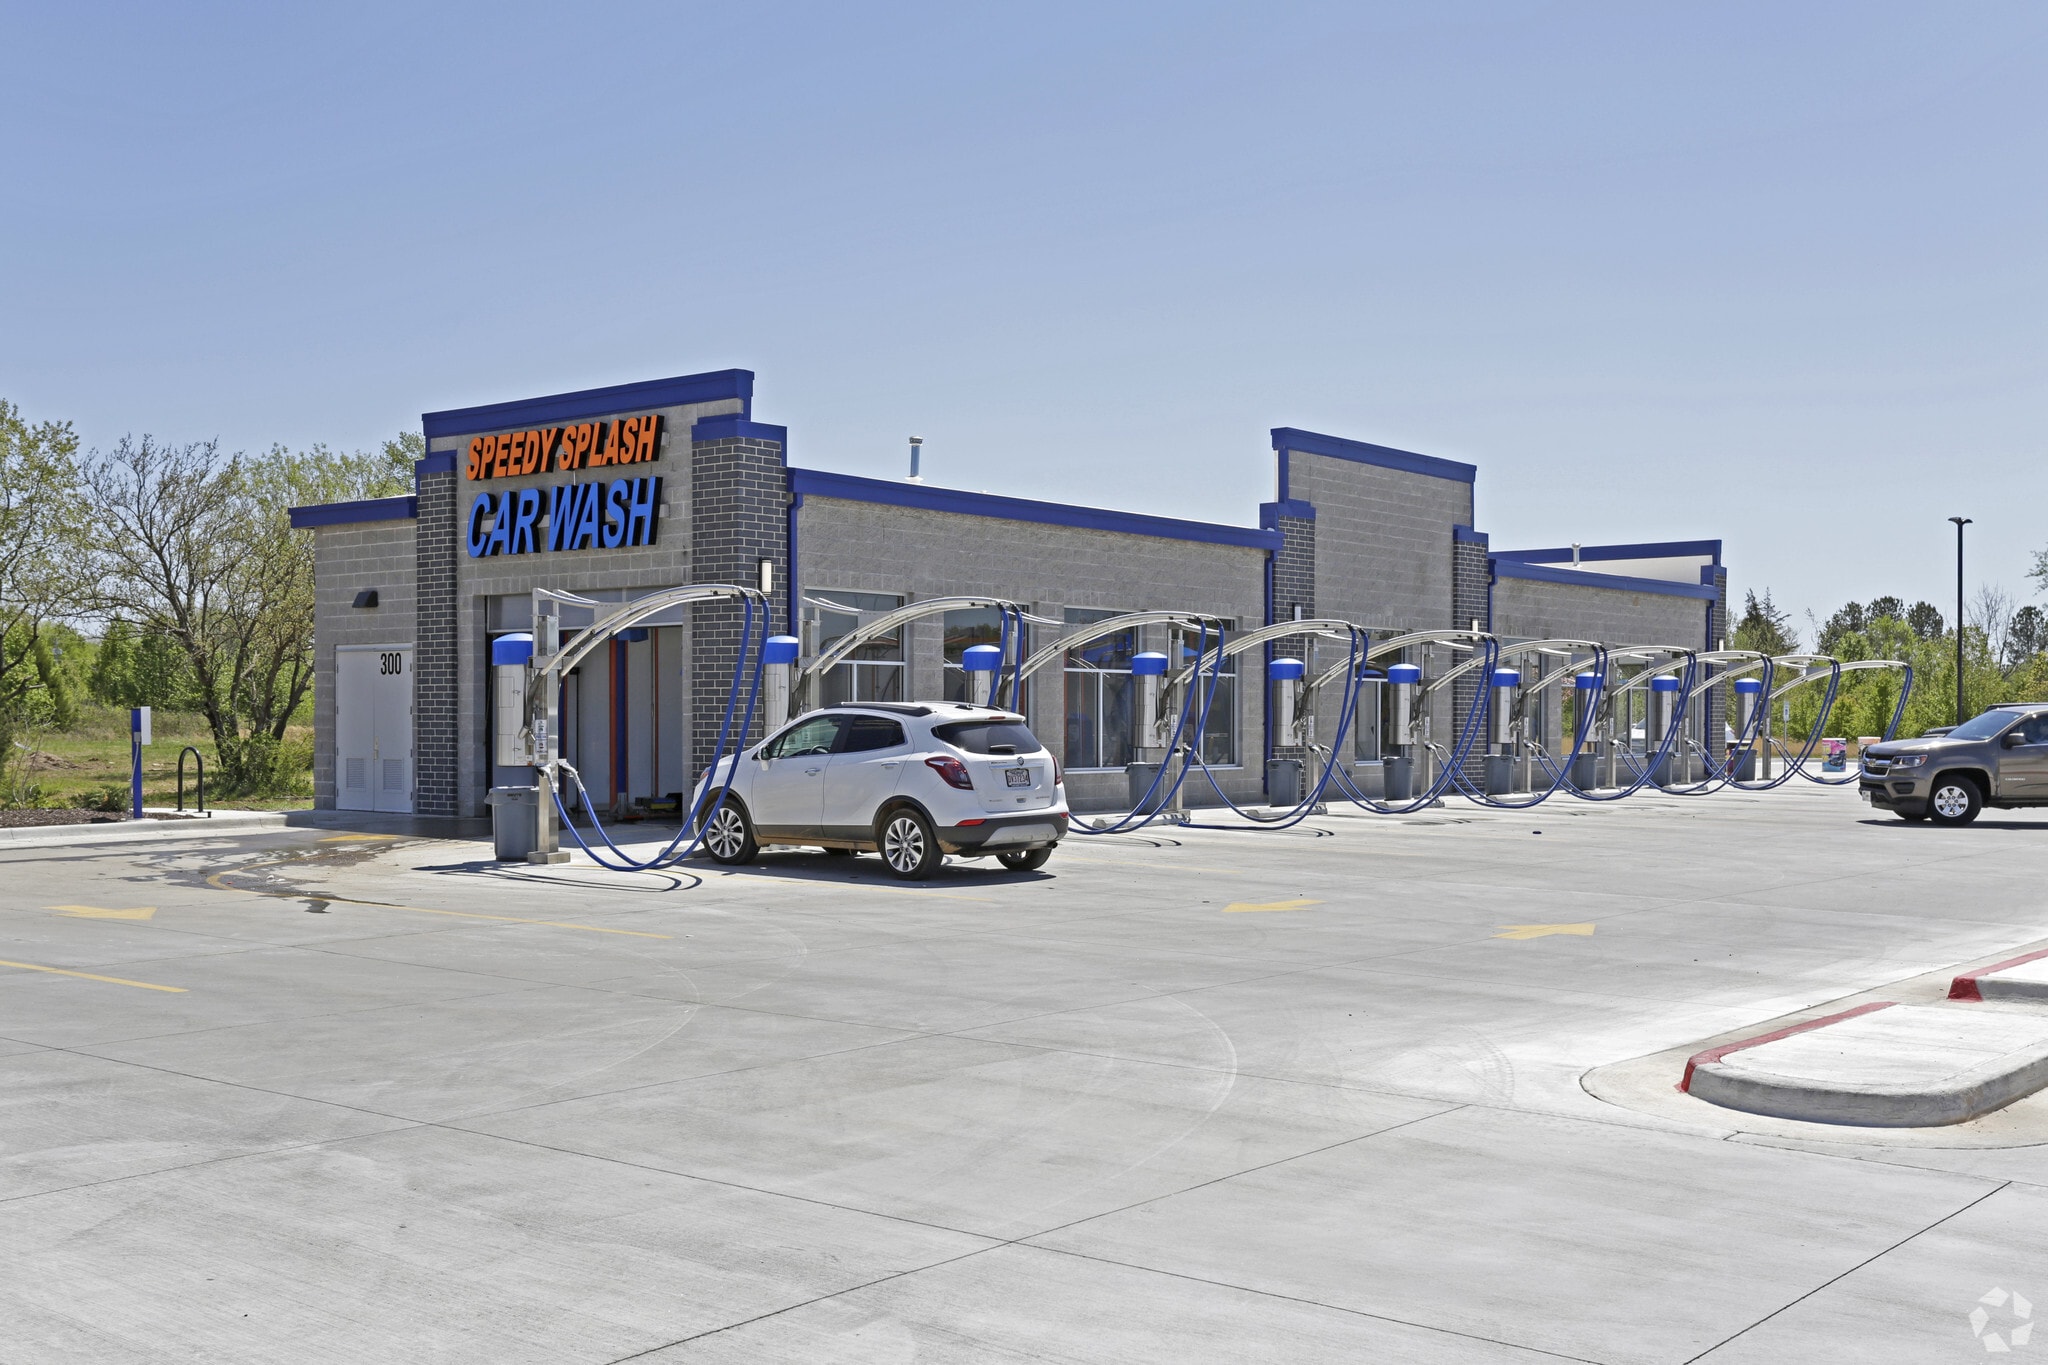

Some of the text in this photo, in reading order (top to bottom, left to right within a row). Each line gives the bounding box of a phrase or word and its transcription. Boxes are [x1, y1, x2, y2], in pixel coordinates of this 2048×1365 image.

[466, 414, 662, 481] SPEEDY SPLASH
[466, 476, 660, 558] CAR WASH
[380, 652, 402, 675] 300
